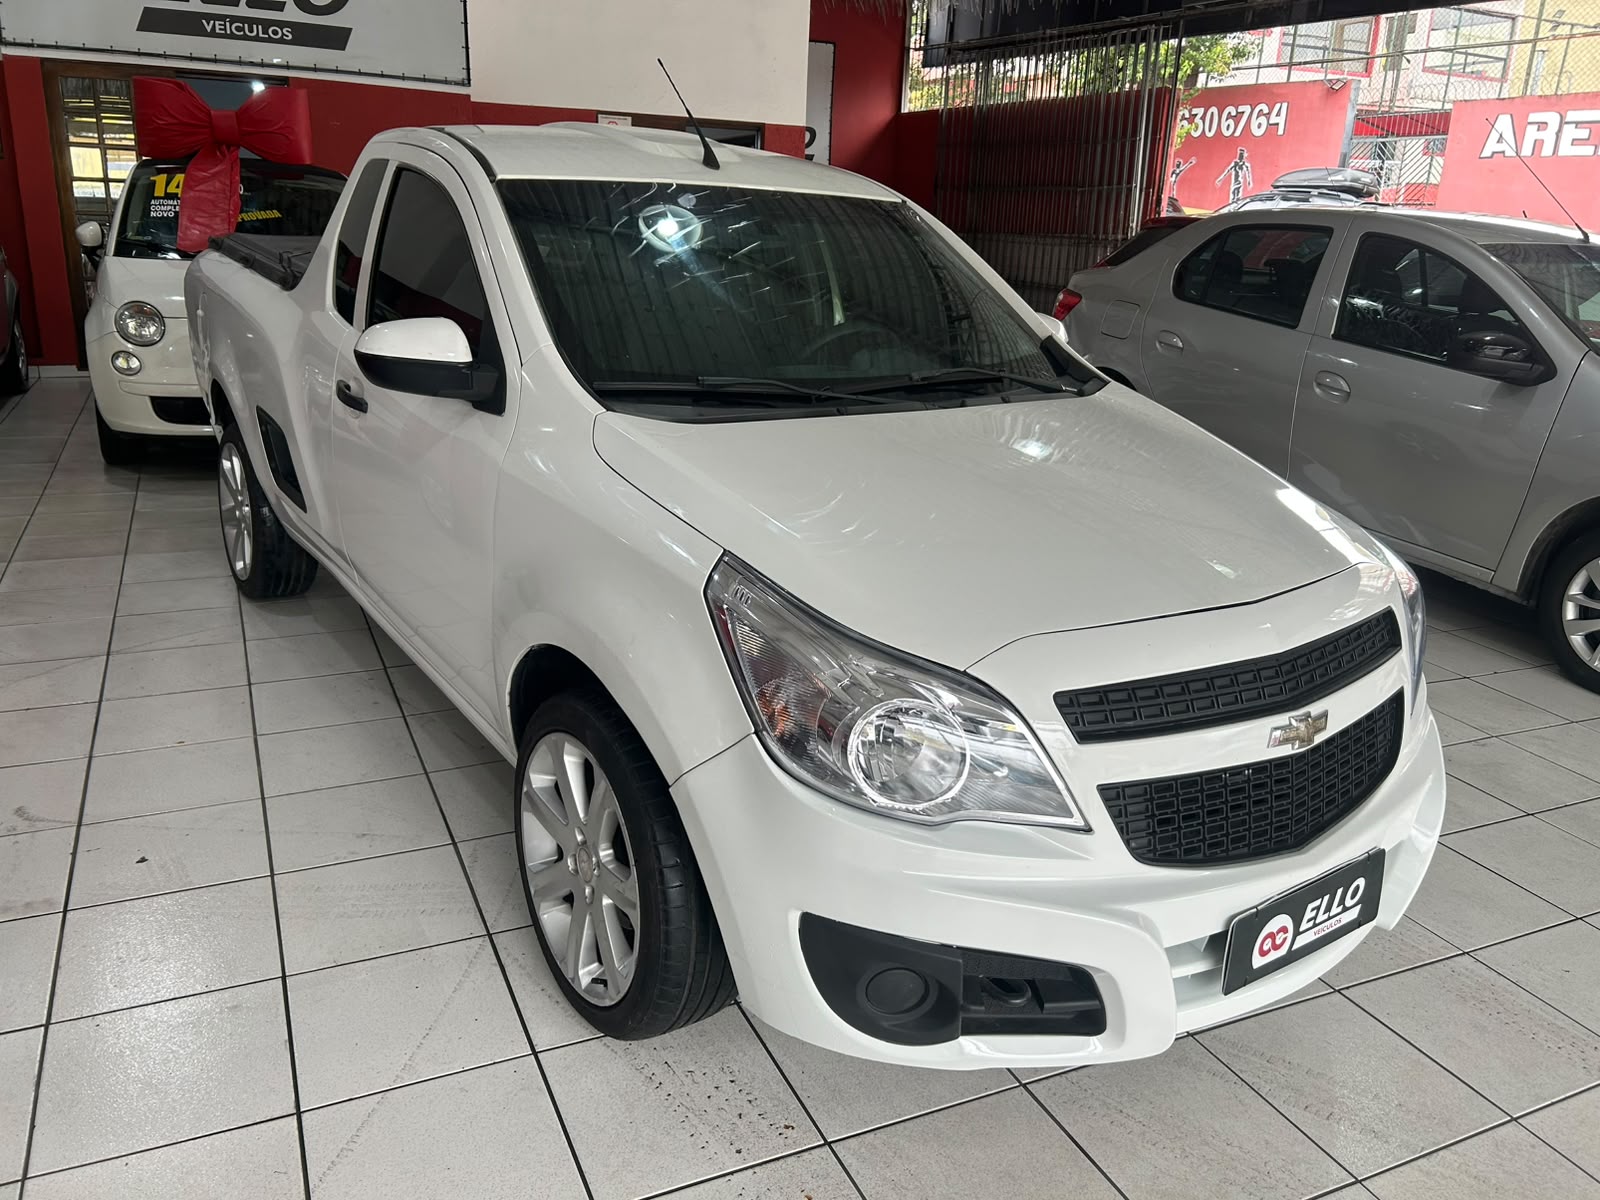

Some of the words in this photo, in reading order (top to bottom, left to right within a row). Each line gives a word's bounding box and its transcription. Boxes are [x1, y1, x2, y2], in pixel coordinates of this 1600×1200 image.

[201, 19, 293, 41] VEÍCULOS
[1479, 109, 1600, 159] ARE
[150, 173, 185, 197] 14
[1299, 877, 1366, 932] ELLO
